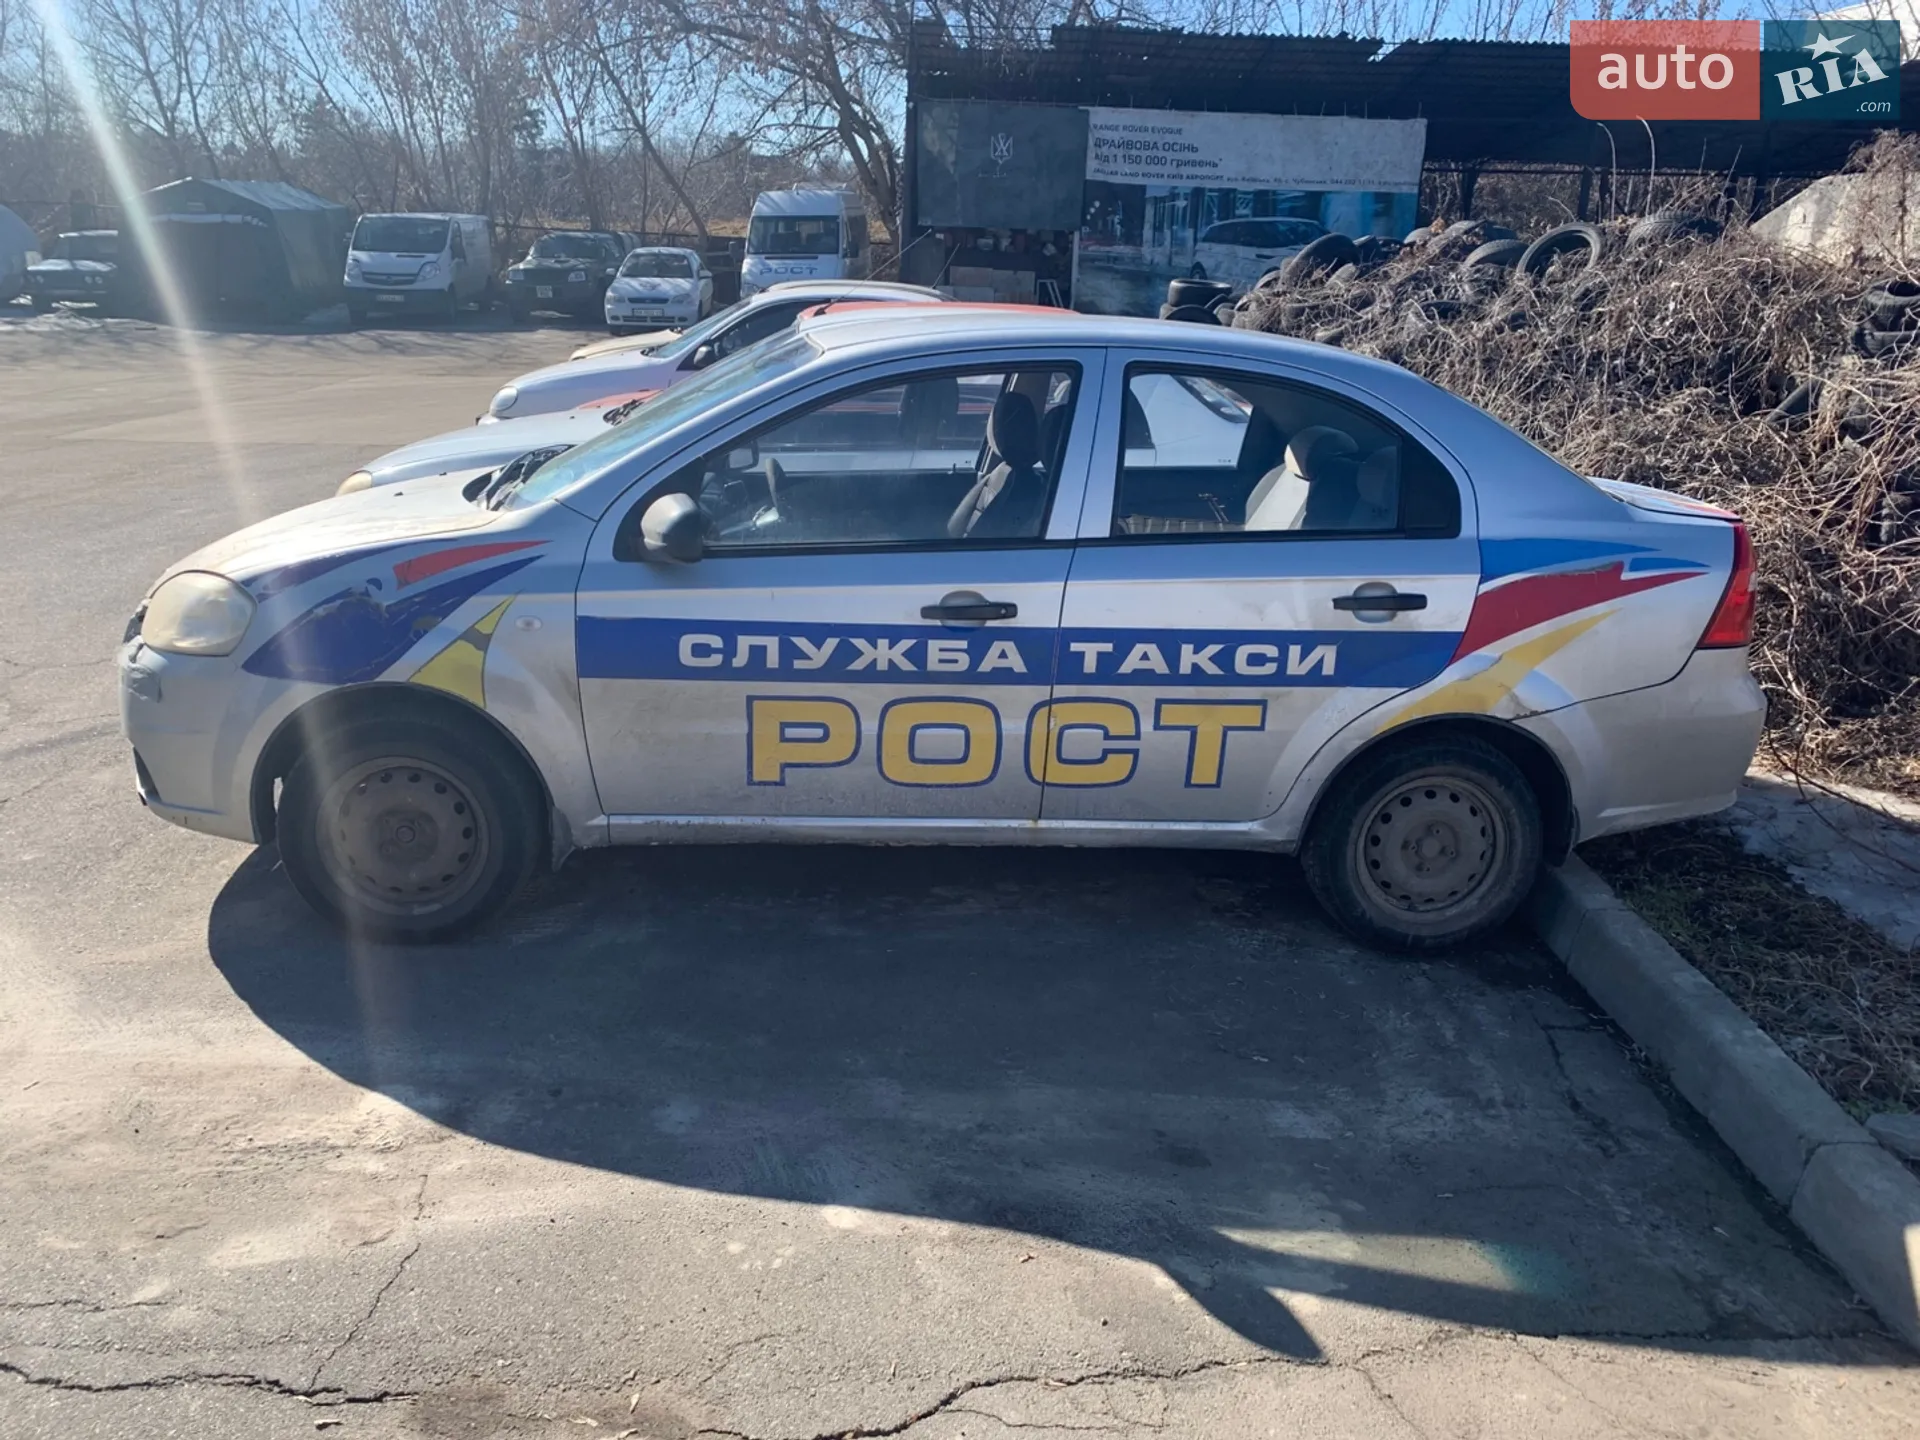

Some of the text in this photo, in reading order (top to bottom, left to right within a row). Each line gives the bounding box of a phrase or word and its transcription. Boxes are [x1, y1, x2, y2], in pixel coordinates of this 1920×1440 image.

[1092, 123, 1183, 136] RANGE ROVER EVOQUE
[1093, 137, 1199, 154] ДРАЙВОВА ОСІНЬ
[1113, 154, 1118, 163] 1
[1122, 154, 1142, 165] 150
[1145, 155, 1168, 166] 000
[759, 266, 818, 276] РОСТ
[678, 633, 1339, 676] СЛУЖБА ТАКСИ
[746, 695, 1268, 788] РОСТ
